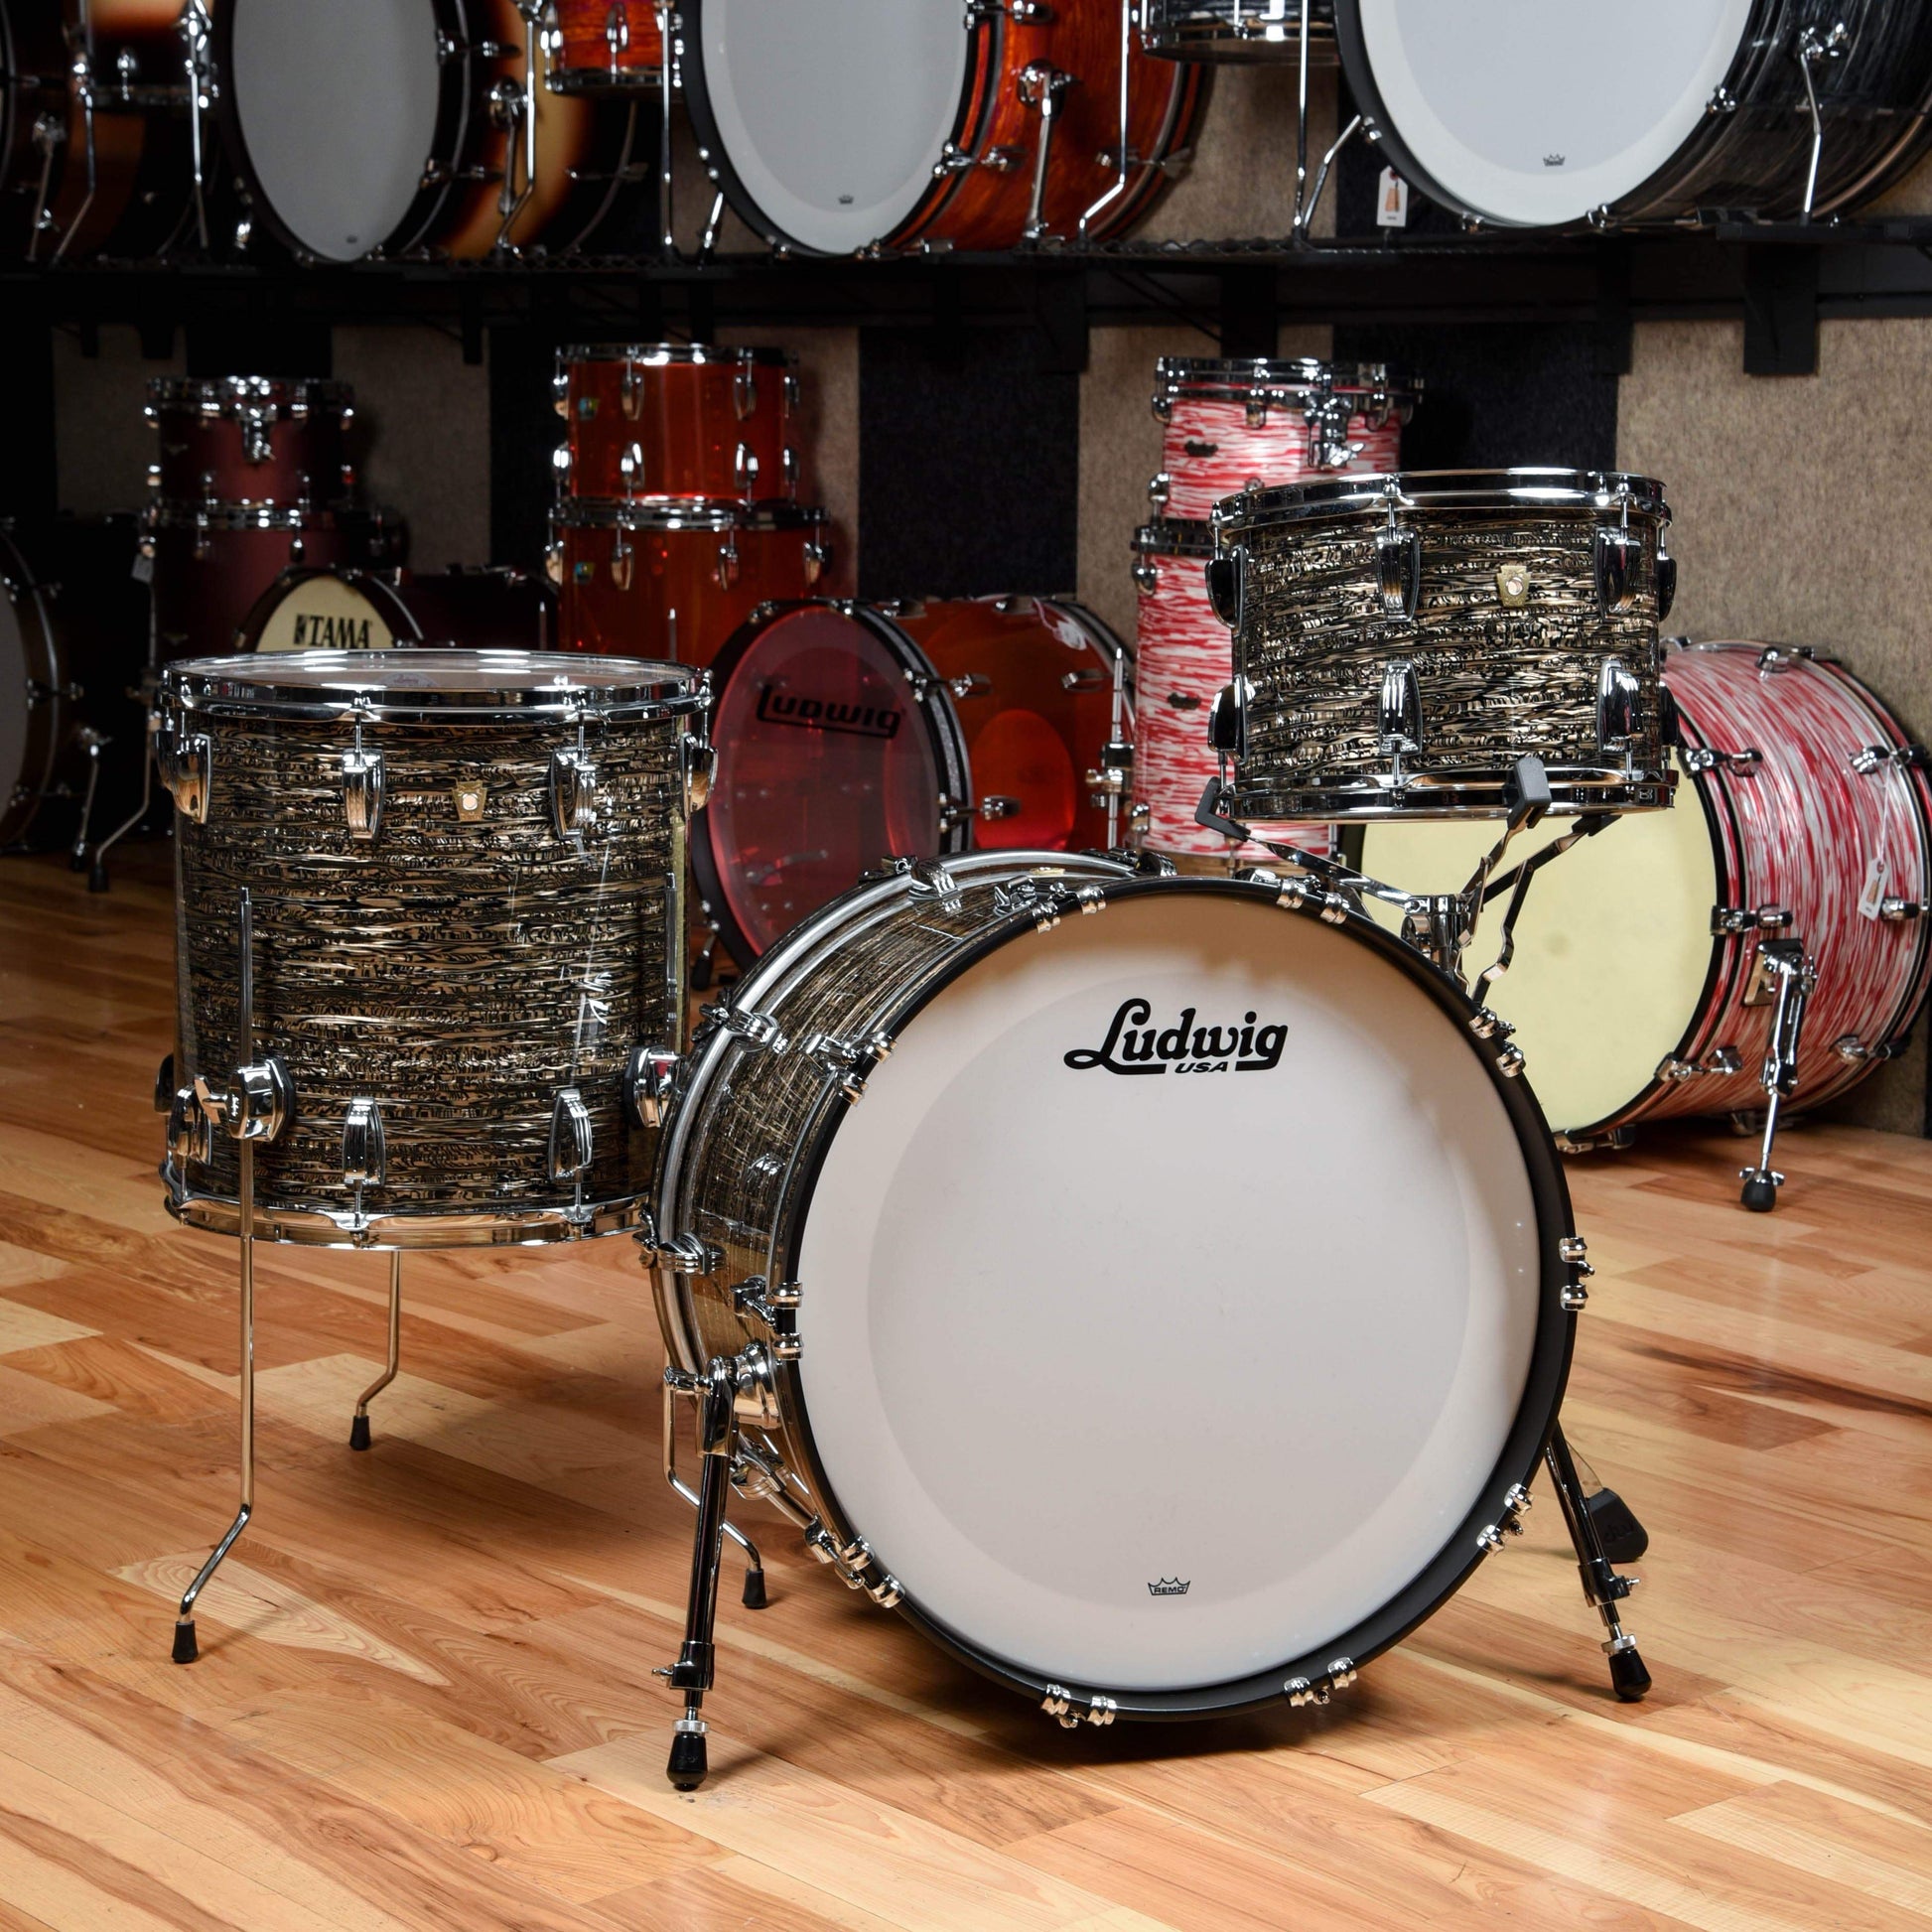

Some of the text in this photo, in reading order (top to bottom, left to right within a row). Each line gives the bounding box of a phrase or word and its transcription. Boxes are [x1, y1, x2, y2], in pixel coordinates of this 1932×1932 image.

[309, 616, 370, 648] TAMA
[1063, 998, 1289, 1075] Ludwig
[1174, 1061, 1228, 1074] USA
